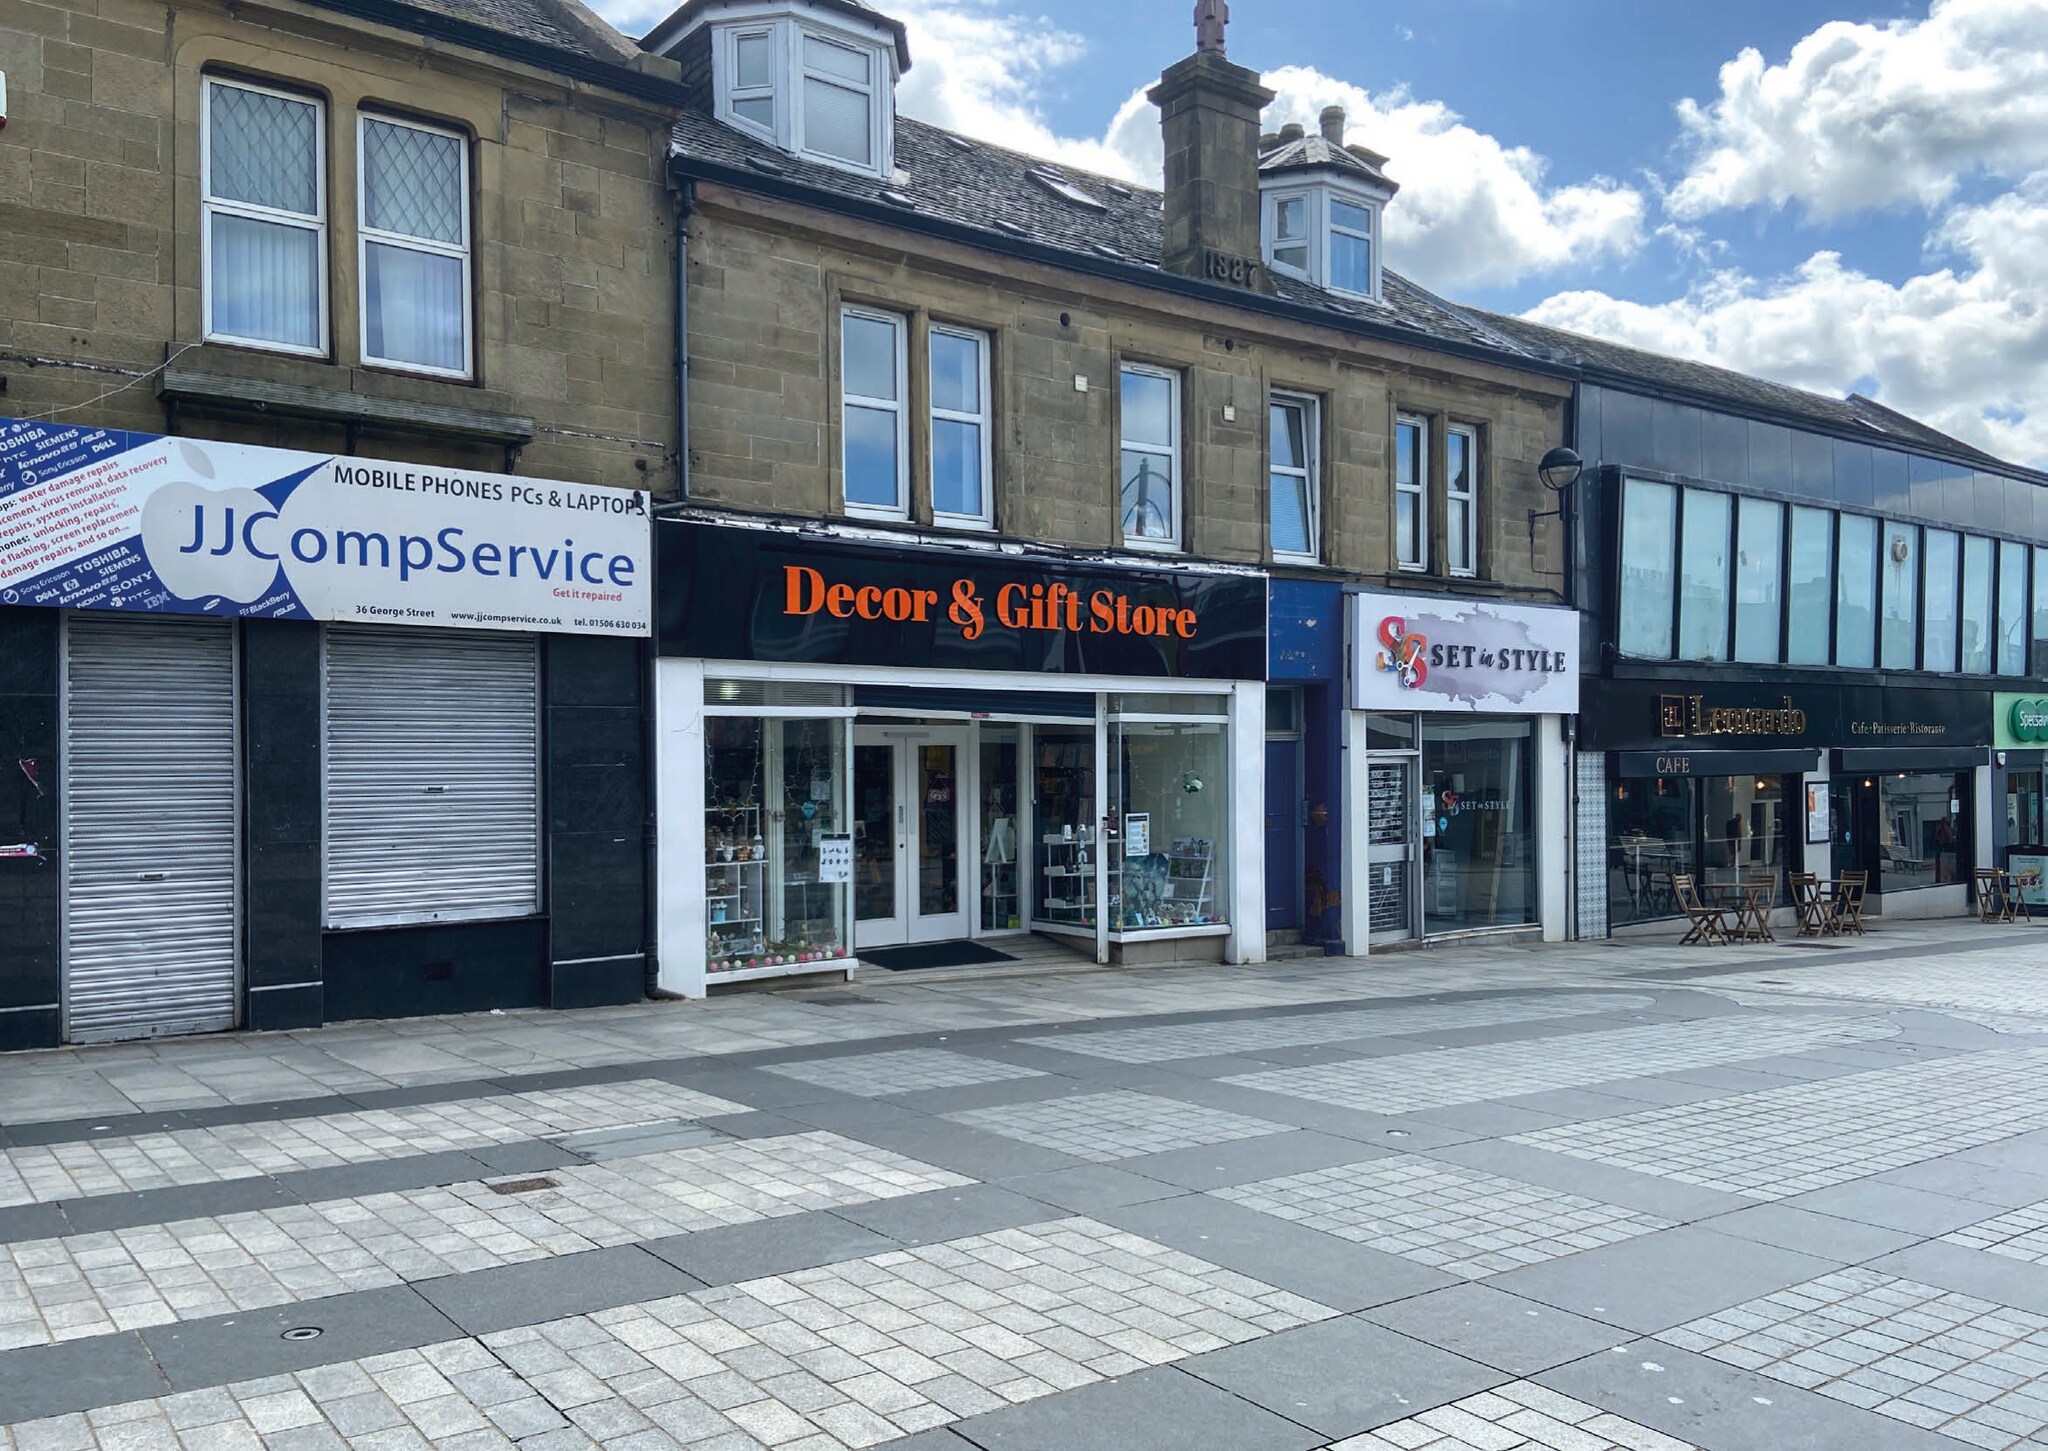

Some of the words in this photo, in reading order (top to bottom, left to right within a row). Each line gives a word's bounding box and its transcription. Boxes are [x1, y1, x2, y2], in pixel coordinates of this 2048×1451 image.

[1204, 250, 1259, 288] 1887
[0, 428, 47, 451] OSHIBA
[35, 429, 79, 450] SIEMENS
[91, 439, 117, 453] DELL
[18, 449, 61, 470] lenovo
[38, 465, 59, 477] Sony
[57, 454, 88, 469] Ericsson
[0, 499, 17, 512] ops:
[18, 488, 47, 503] water
[48, 474, 86, 492] damage
[87, 461, 119, 478] repairs
[0, 505, 40, 525] cement,
[41, 495, 65, 508] virus
[65, 479, 106, 499] removal,
[107, 471, 129, 483] data
[129, 456, 167, 475] recovery
[334, 465, 416, 491] MOBILE
[422, 475, 503, 501] PHONES
[511, 486, 543, 505] PCs
[548, 490, 562, 507] &
[36, 507, 70, 525] system
[69, 484, 128, 511] installations
[33, 516, 83, 538] unlocking,
[83, 501, 119, 519] repairs,
[7, 542, 50, 562] flashing,
[51, 529, 82, 546] screen
[82, 505, 140, 533] replacement
[179, 504, 635, 586] JJCompService
[0, 559, 40, 579] damage
[40, 545, 77, 563] repairs,
[77, 535, 96, 548] and
[96, 532, 107, 541] so
[74, 546, 130, 574] TOSHIBA
[98, 554, 142, 577] SIEMENS
[20, 583, 41, 595] Sony
[39, 570, 71, 587] Ericsson
[59, 583, 102, 605] lenovo
[110, 570, 153, 595] SONY
[553, 588, 571, 598] Get
[572, 588, 580, 599] it
[581, 590, 622, 602] repaired
[34, 588, 60, 603] DELL
[76, 592, 107, 609] NOKIA
[143, 591, 171, 609] IBM
[249, 591, 290, 614] BlackBerry
[782, 565, 938, 623] Decor
[948, 579, 984, 640] &
[996, 582, 1084, 632] Gift
[1090, 590, 1197, 639] Store
[355, 605, 368, 614] 36
[370, 605, 405, 618] George
[406, 607, 435, 618] Street
[451, 611, 562, 625] www.jjcompservice.co.uk
[574, 617, 589, 627] tel.
[589, 619, 615, 628] 01506
[615, 620, 631, 629] 630
[632, 621, 646, 630] 034
[1431, 644, 1476, 668] SET
[1479, 647, 1496, 668] in
[1498, 647, 1566, 673] STYLE
[1689, 694, 1806, 736] Leonardo
[1656, 757, 1690, 774] CAFE
[1460, 801, 1477, 810] SET
